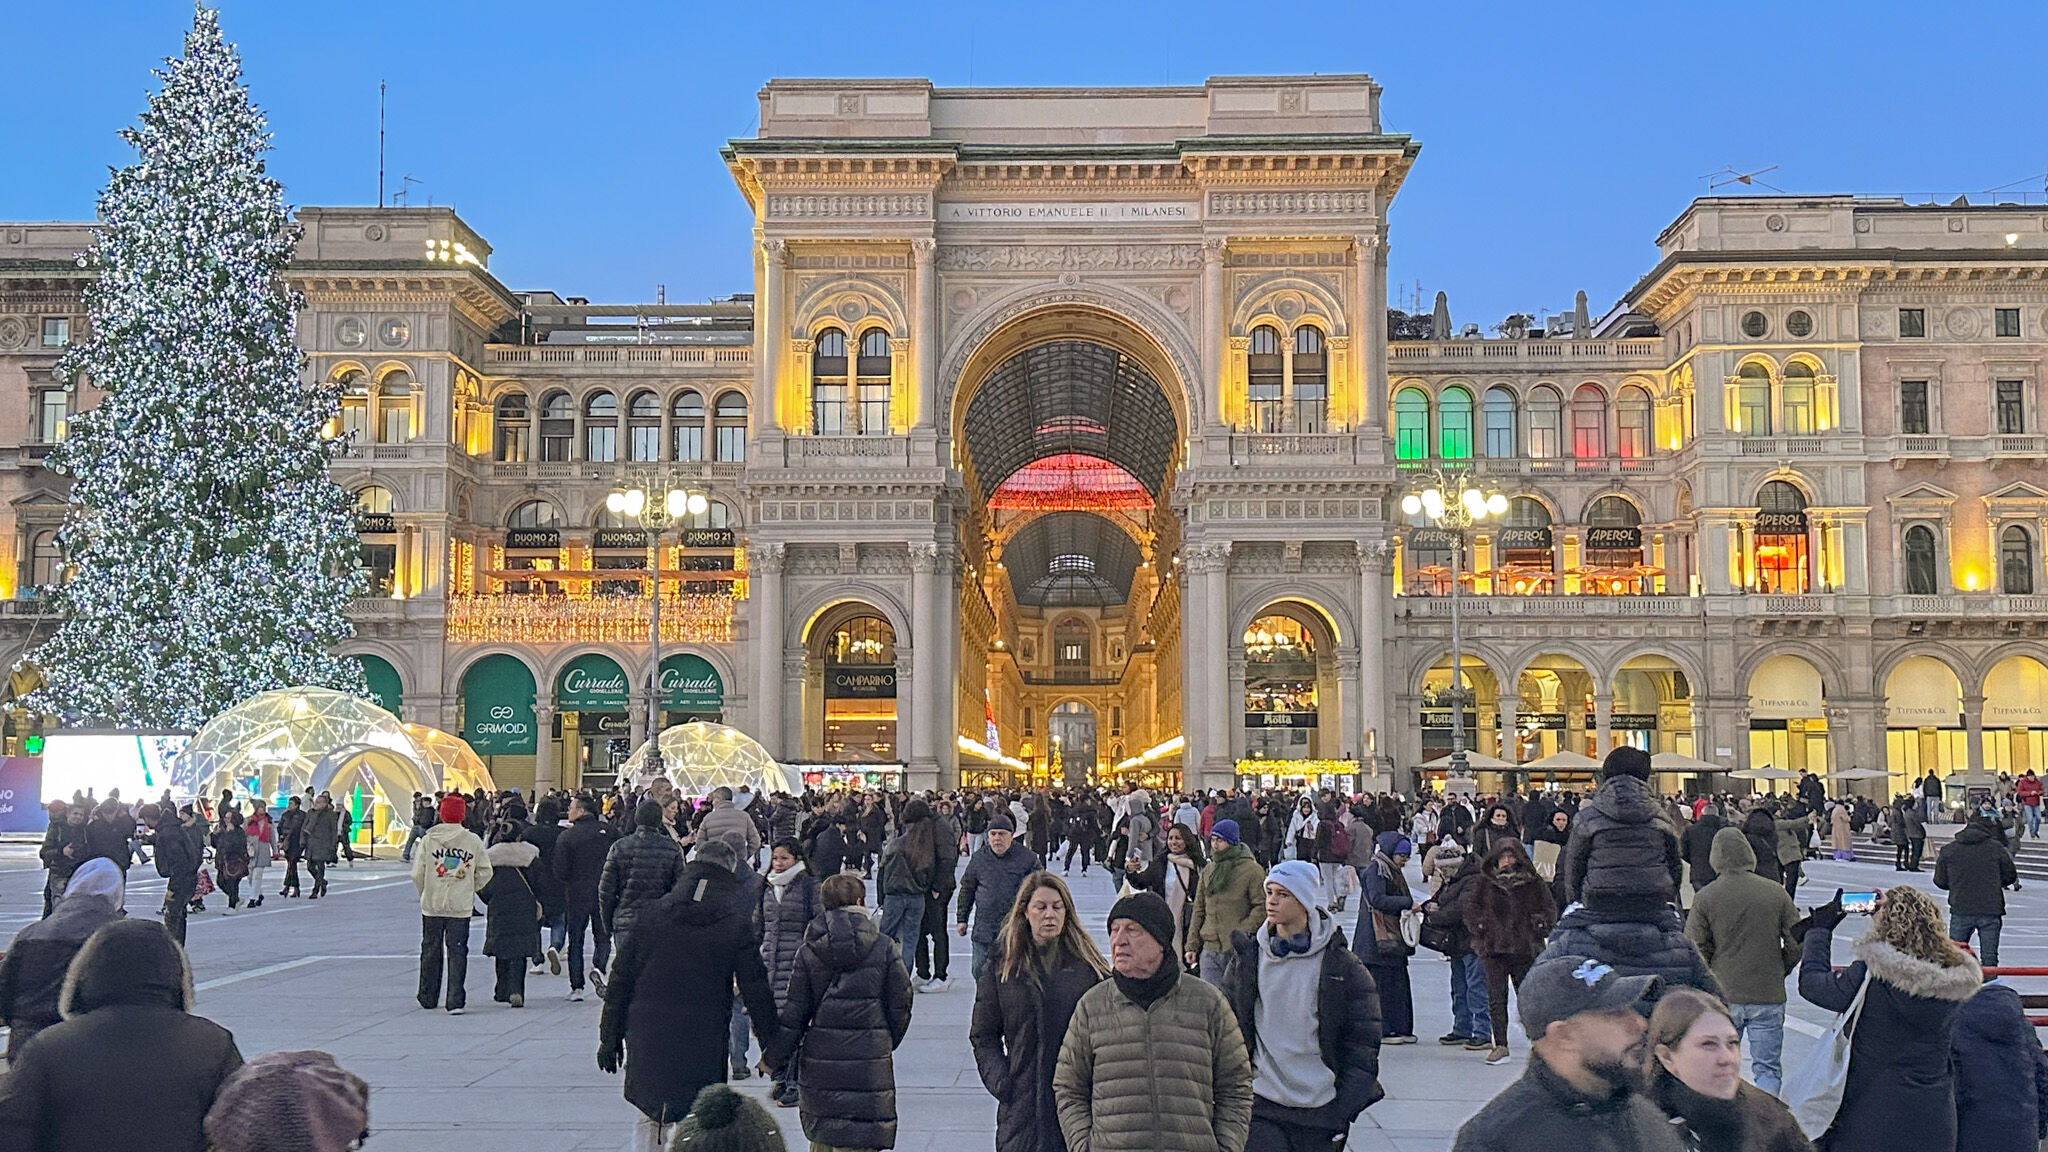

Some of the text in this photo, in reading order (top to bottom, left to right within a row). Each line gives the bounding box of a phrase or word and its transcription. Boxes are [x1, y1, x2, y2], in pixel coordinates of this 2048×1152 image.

[953, 208, 960, 217] A
[968, 208, 1022, 217] VITTORIO
[1029, 207, 1094, 217] EMANUELE
[1100, 207, 1108, 217] II
[1131, 207, 1186, 216] MILANESI
[362, 517, 385, 527] OMO
[1757, 513, 1802, 526] APEROL
[514, 533, 558, 542] DUOMO 21
[601, 533, 633, 542] DUOMO
[687, 532, 731, 542] DUOMO 21
[1414, 530, 1452, 542] APERO
[1501, 530, 1545, 541] APEROL
[1590, 529, 1635, 541] APEROL
[564, 668, 625, 693] Currado
[658, 668, 718, 693] Currado
[836, 674, 894, 686] CAMPARINO
[1263, 714, 1293, 724] Motta
[476, 723, 528, 735] GRIMOLDI
